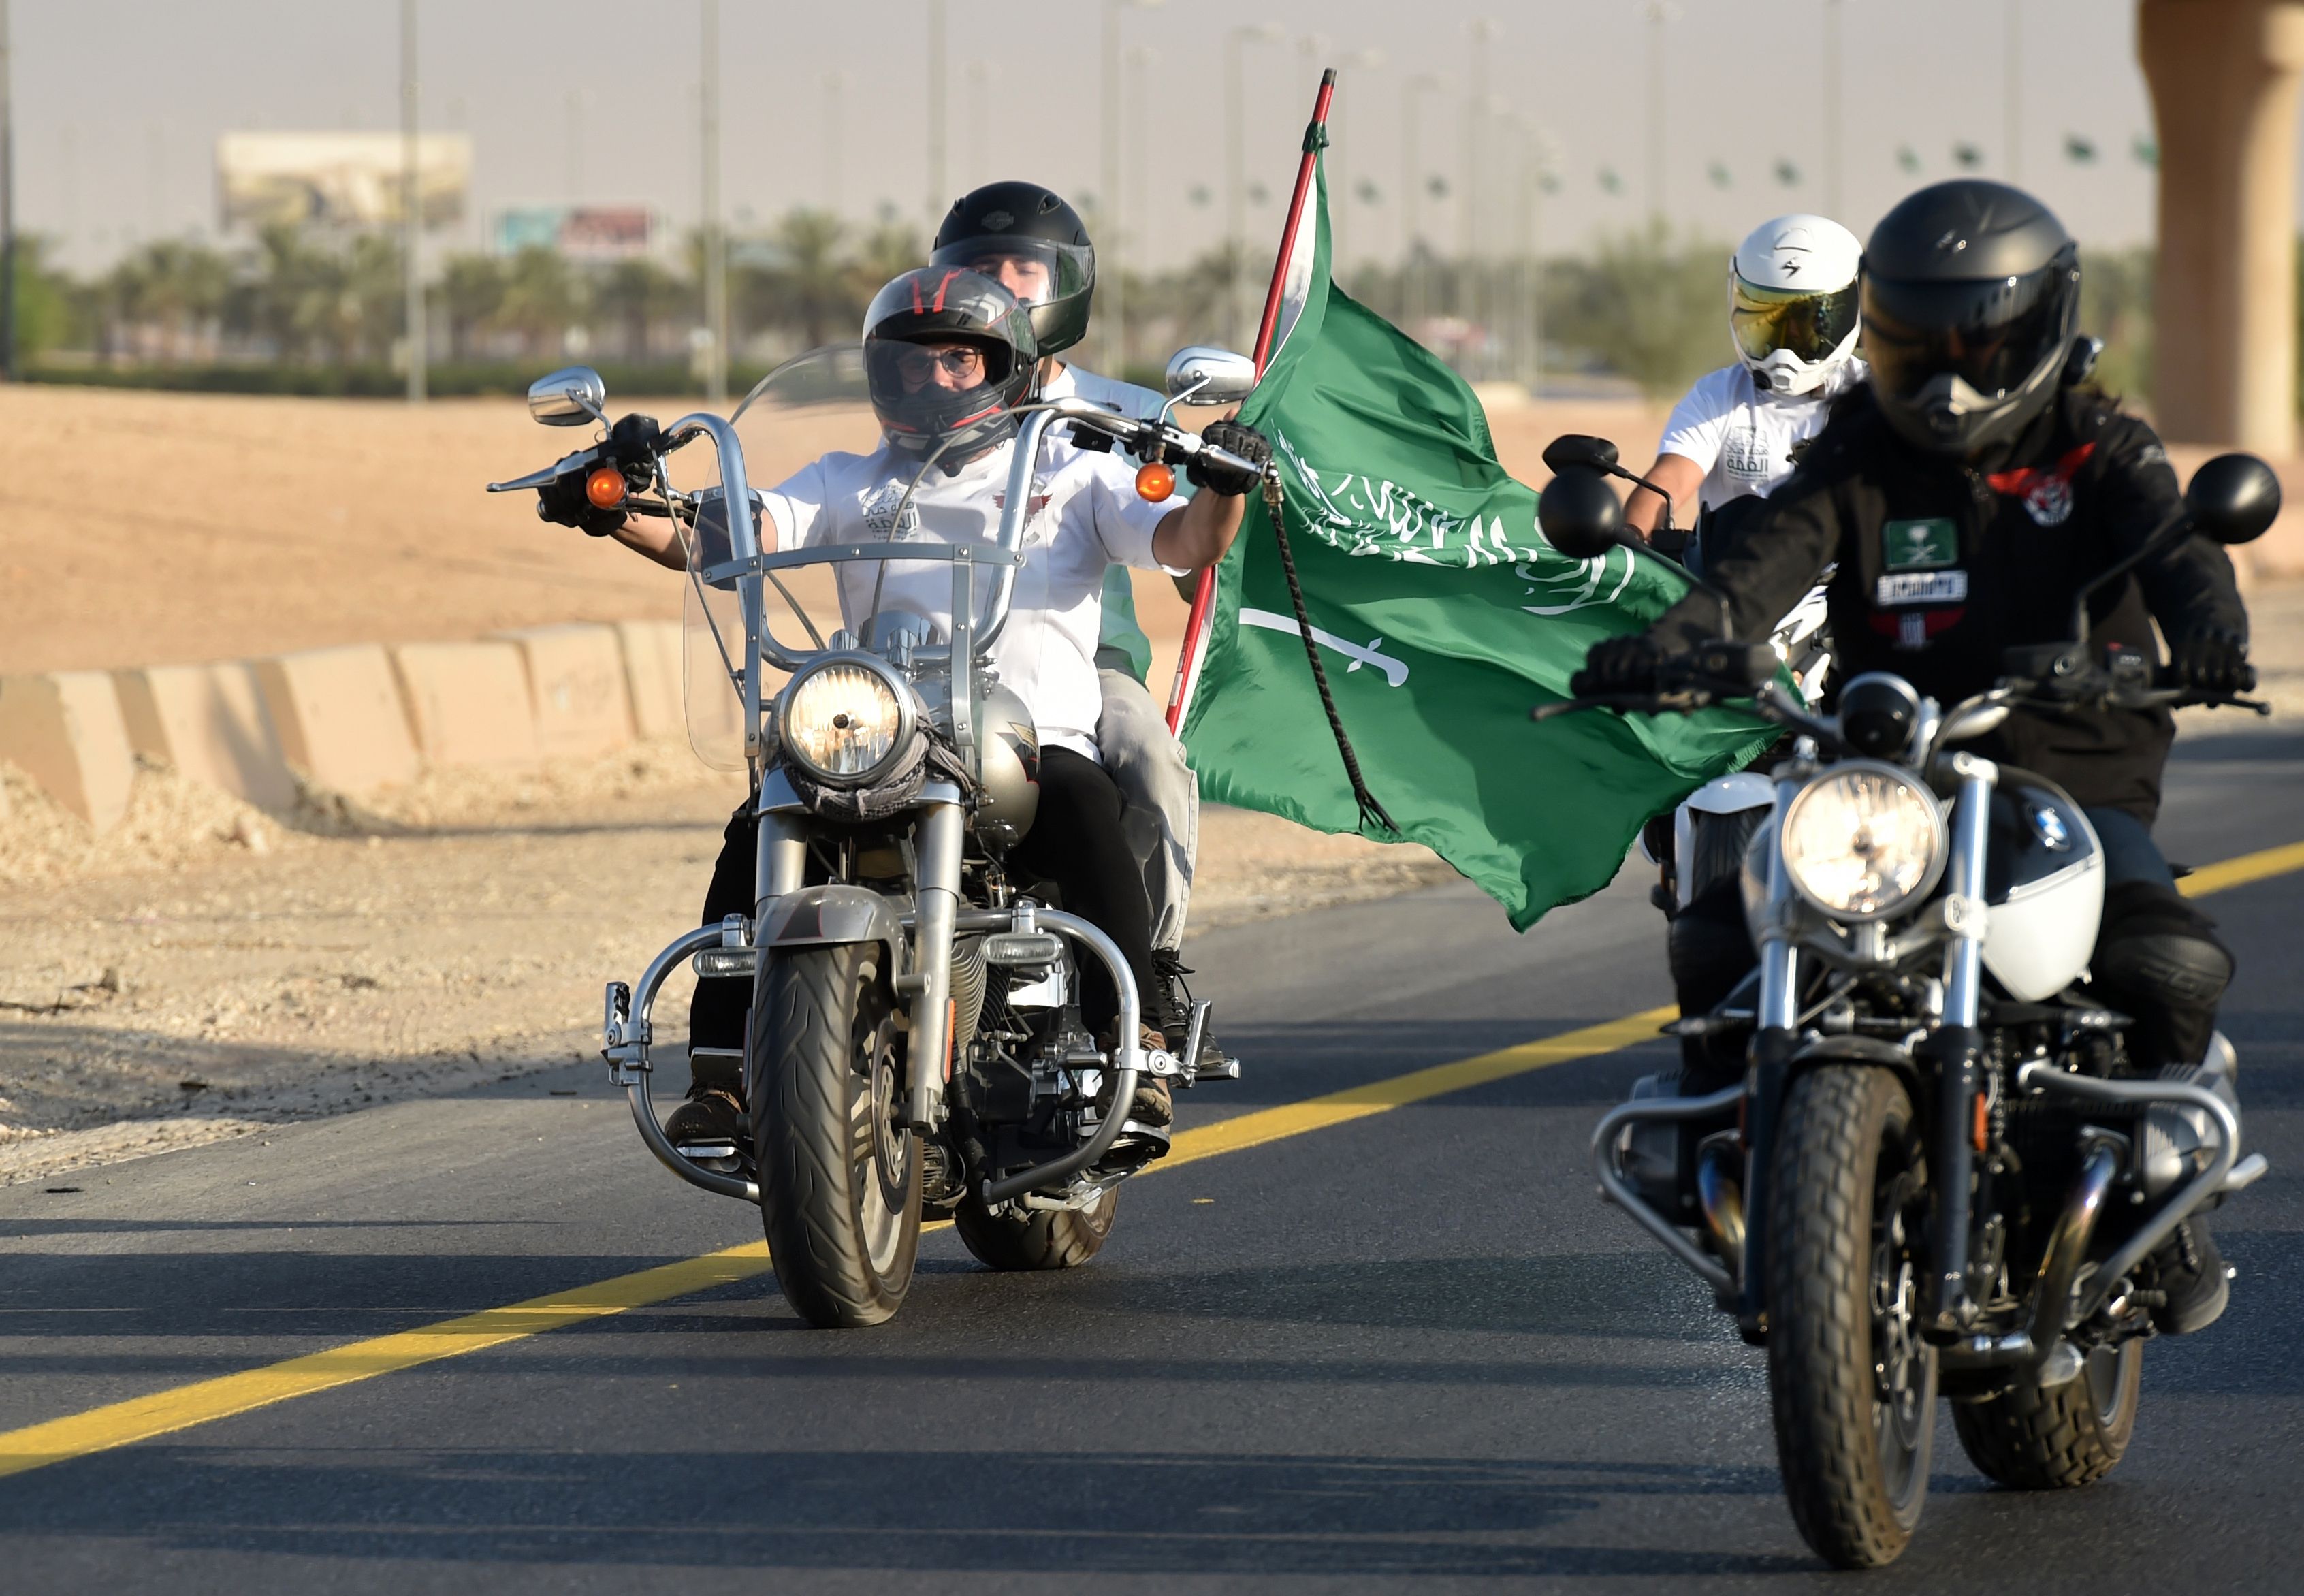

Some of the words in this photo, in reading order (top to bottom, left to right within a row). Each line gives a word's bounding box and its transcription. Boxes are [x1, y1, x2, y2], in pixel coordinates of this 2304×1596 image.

[1727, 454, 1769, 472] القمة
[862, 505, 888, 517] حتى
[891, 501, 914, 511] هة
